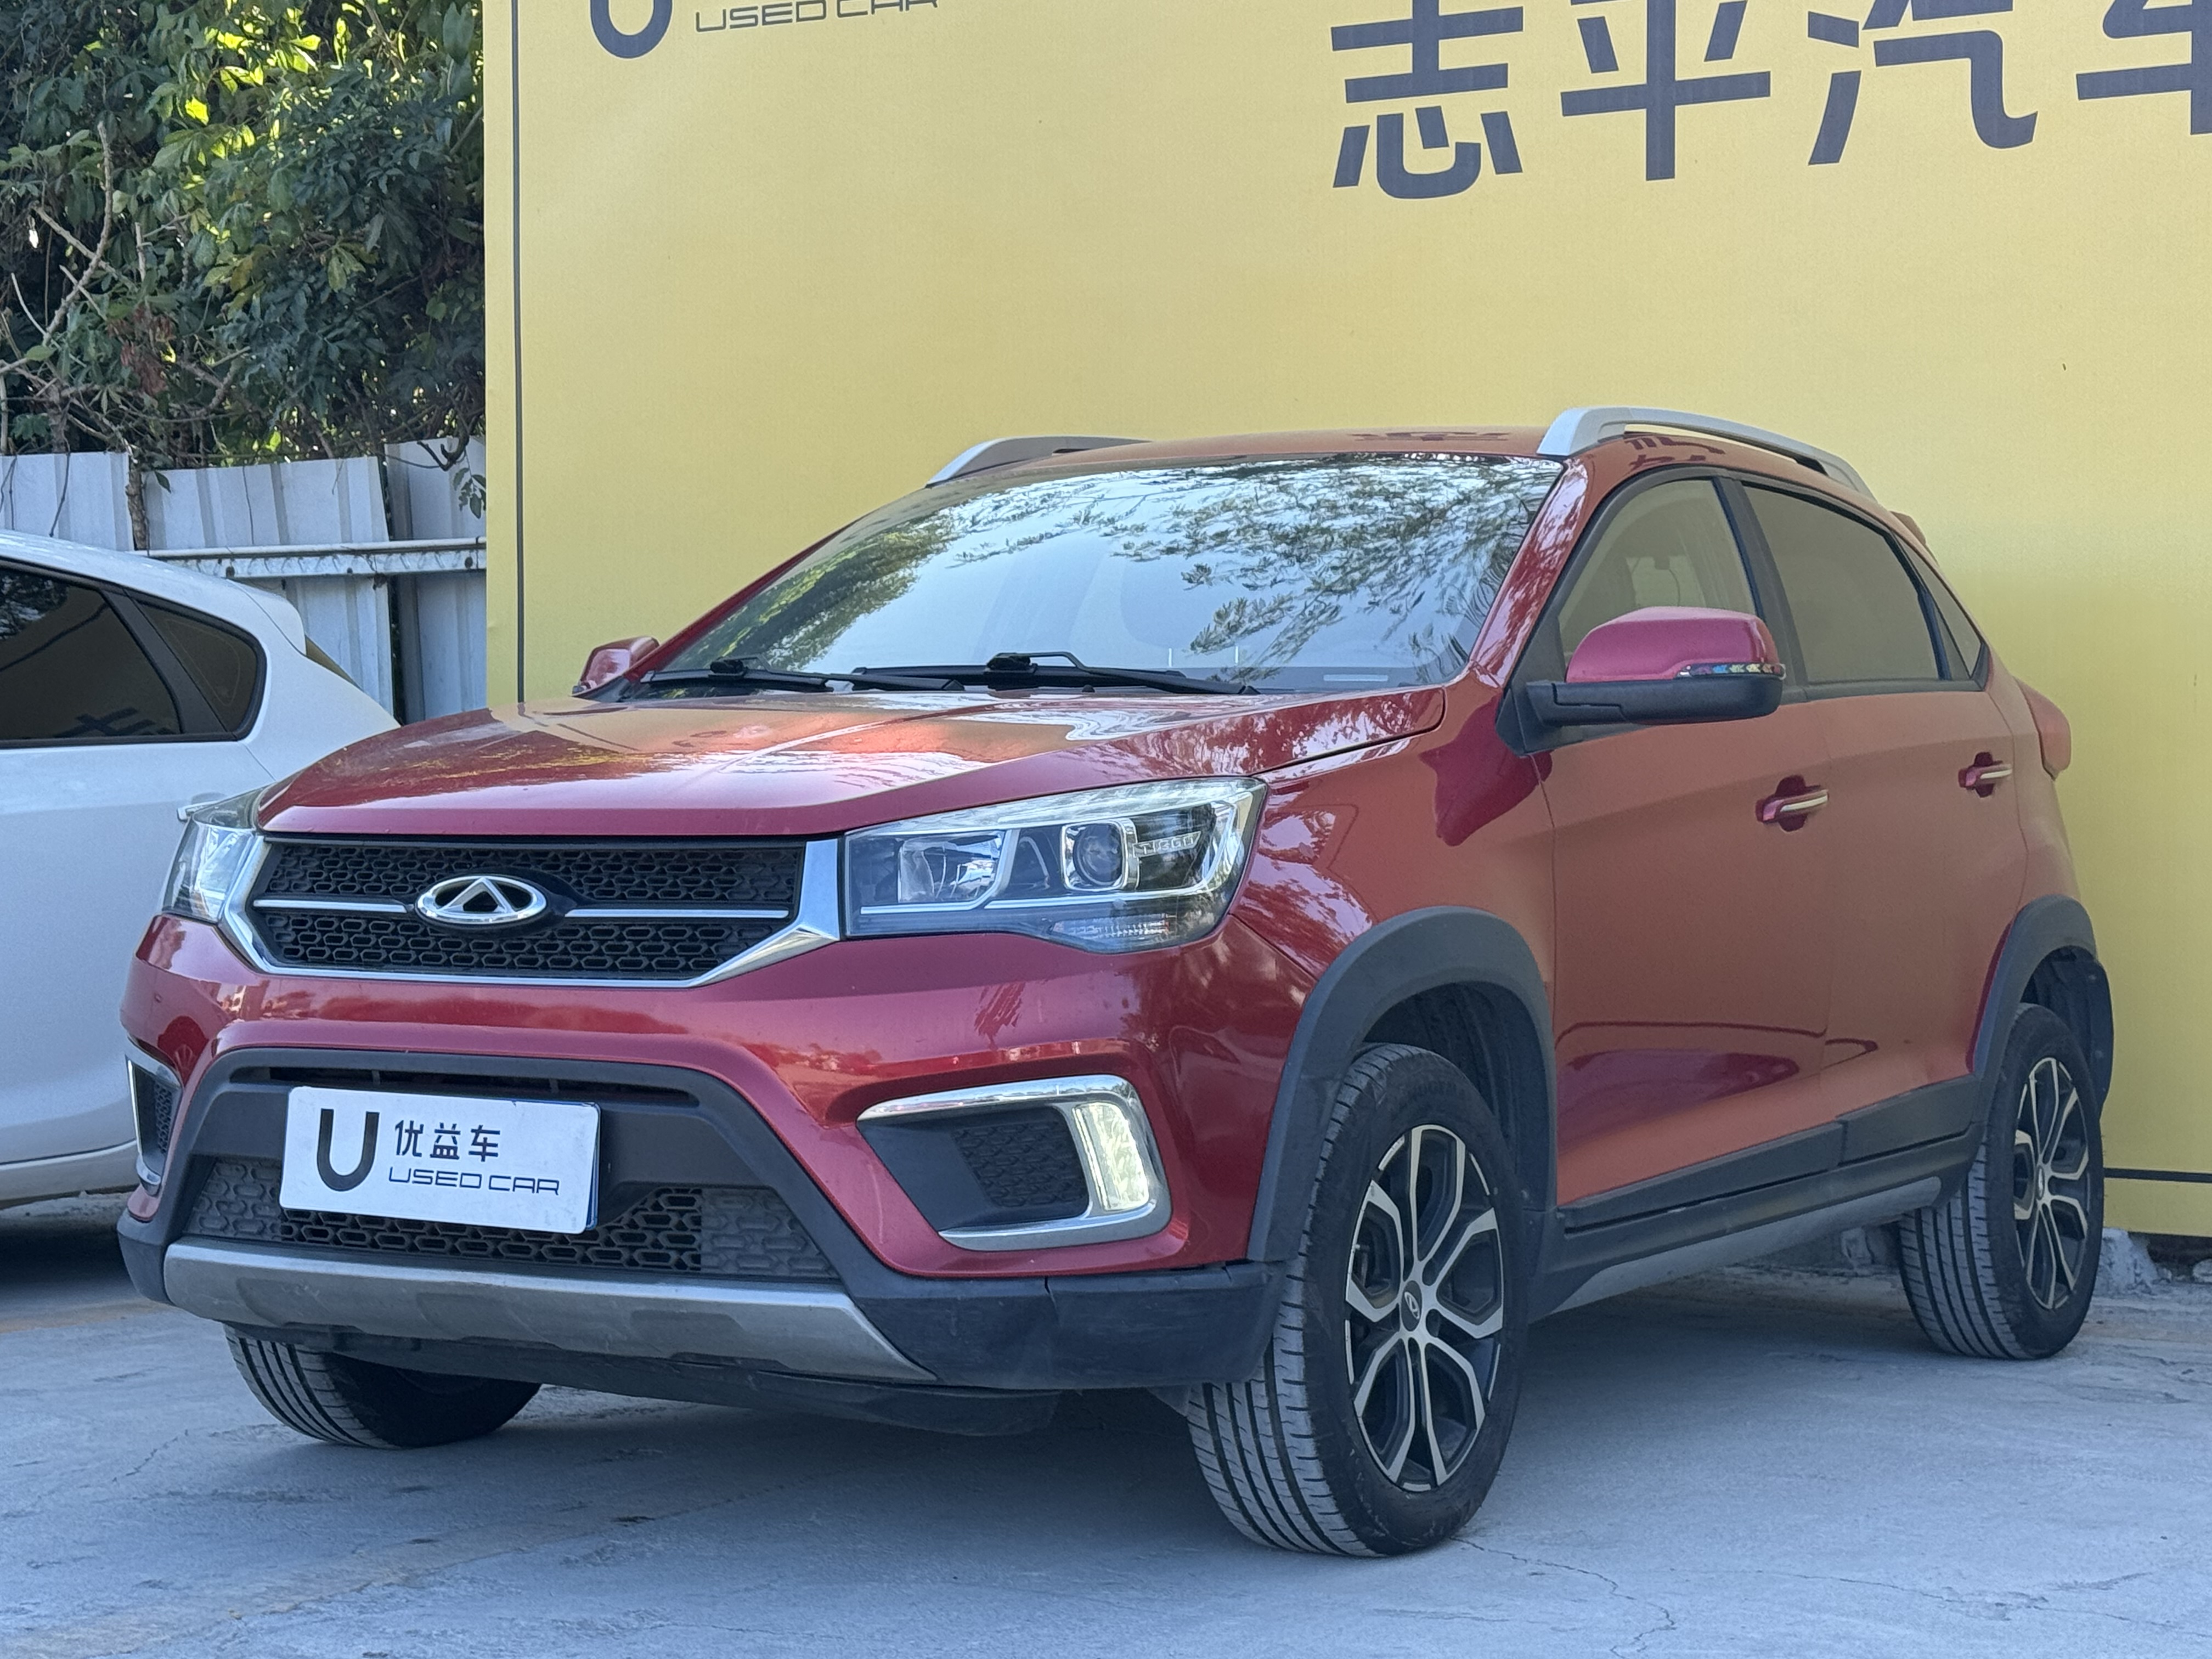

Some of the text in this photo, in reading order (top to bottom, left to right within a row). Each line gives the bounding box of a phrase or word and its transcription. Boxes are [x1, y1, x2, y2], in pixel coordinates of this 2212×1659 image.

[695, 0, 827, 32] USED
[317, 1108, 380, 1192] U
[394, 1119, 501, 1163] 优益车
[388, 1166, 560, 1195] USED CAR
